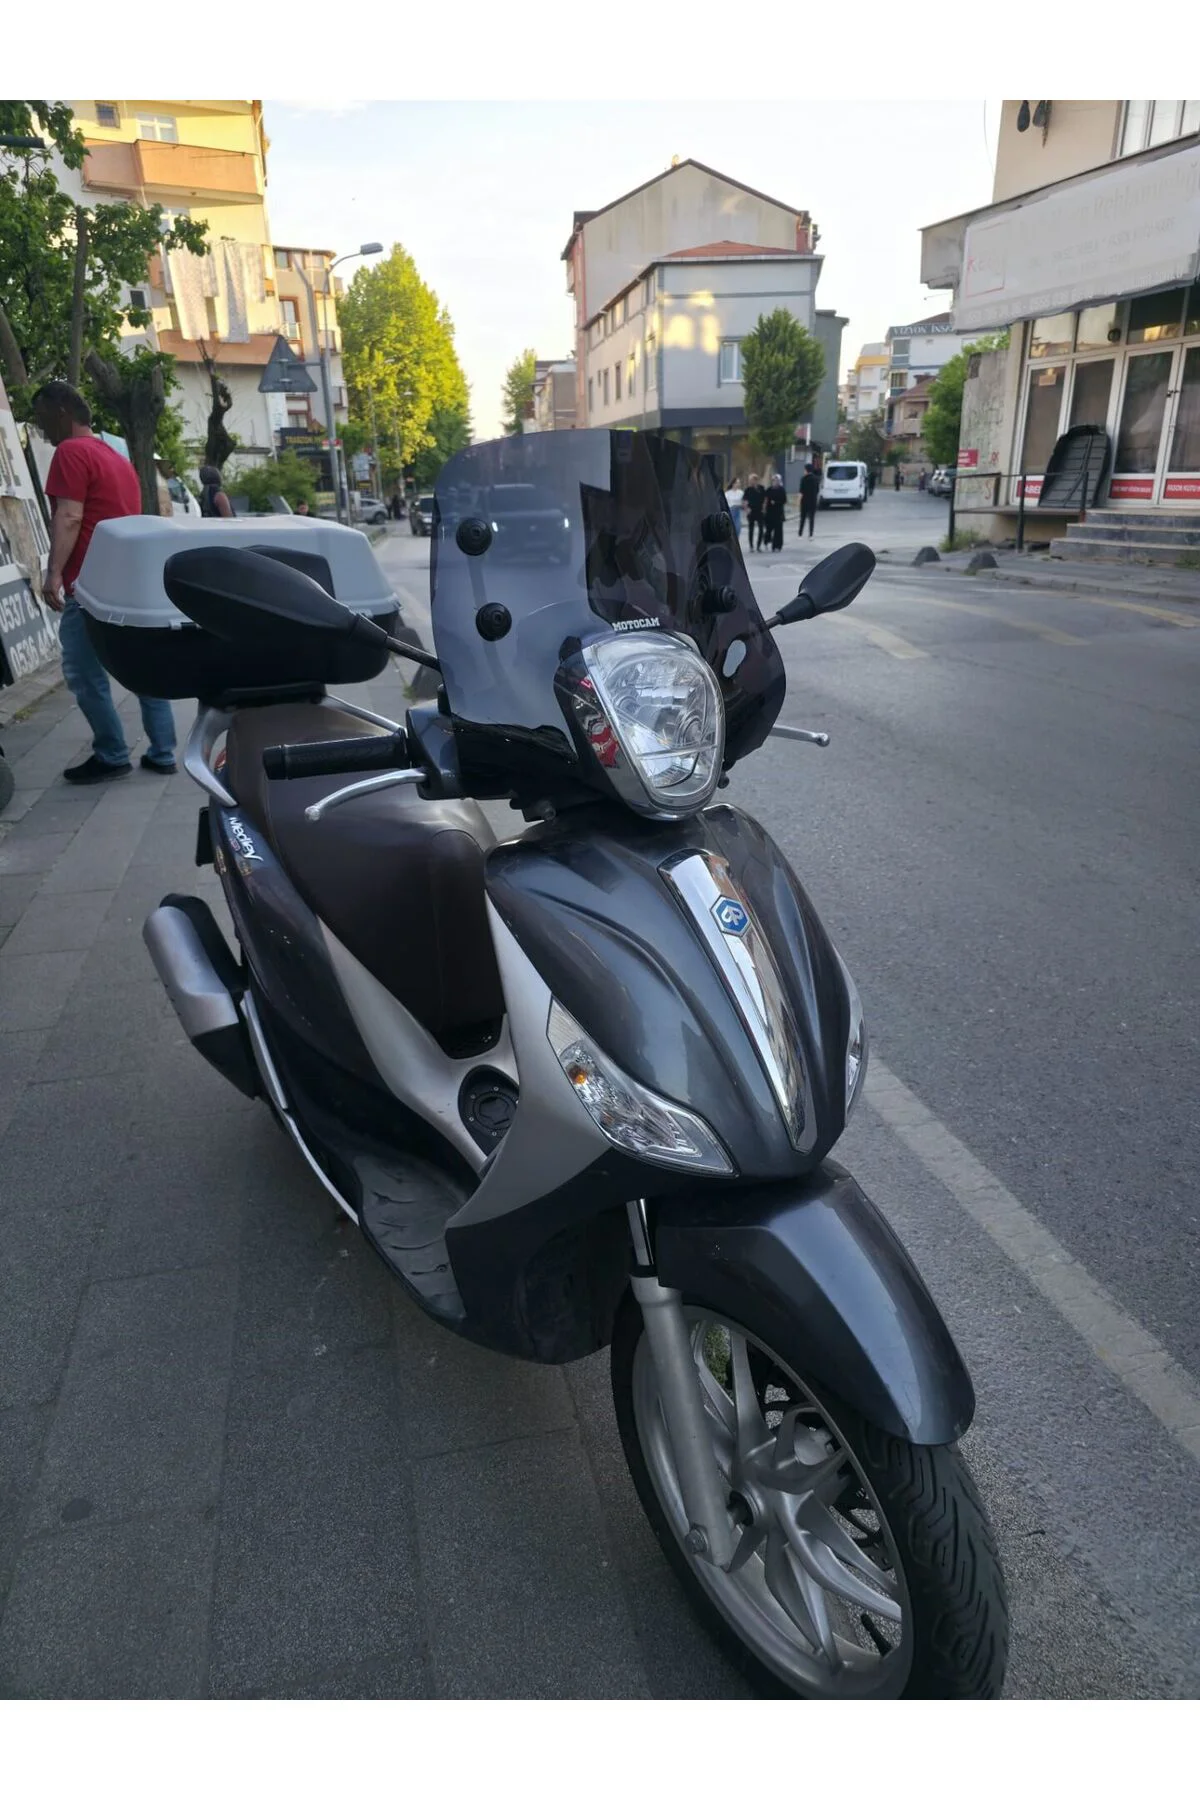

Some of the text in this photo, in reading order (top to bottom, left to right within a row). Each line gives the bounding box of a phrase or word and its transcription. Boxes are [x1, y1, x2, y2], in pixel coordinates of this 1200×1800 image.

[612, 617, 660, 632] MOTOCAM
[10, 635, 39, 678] 0536
[229, 817, 264, 861] Medley
